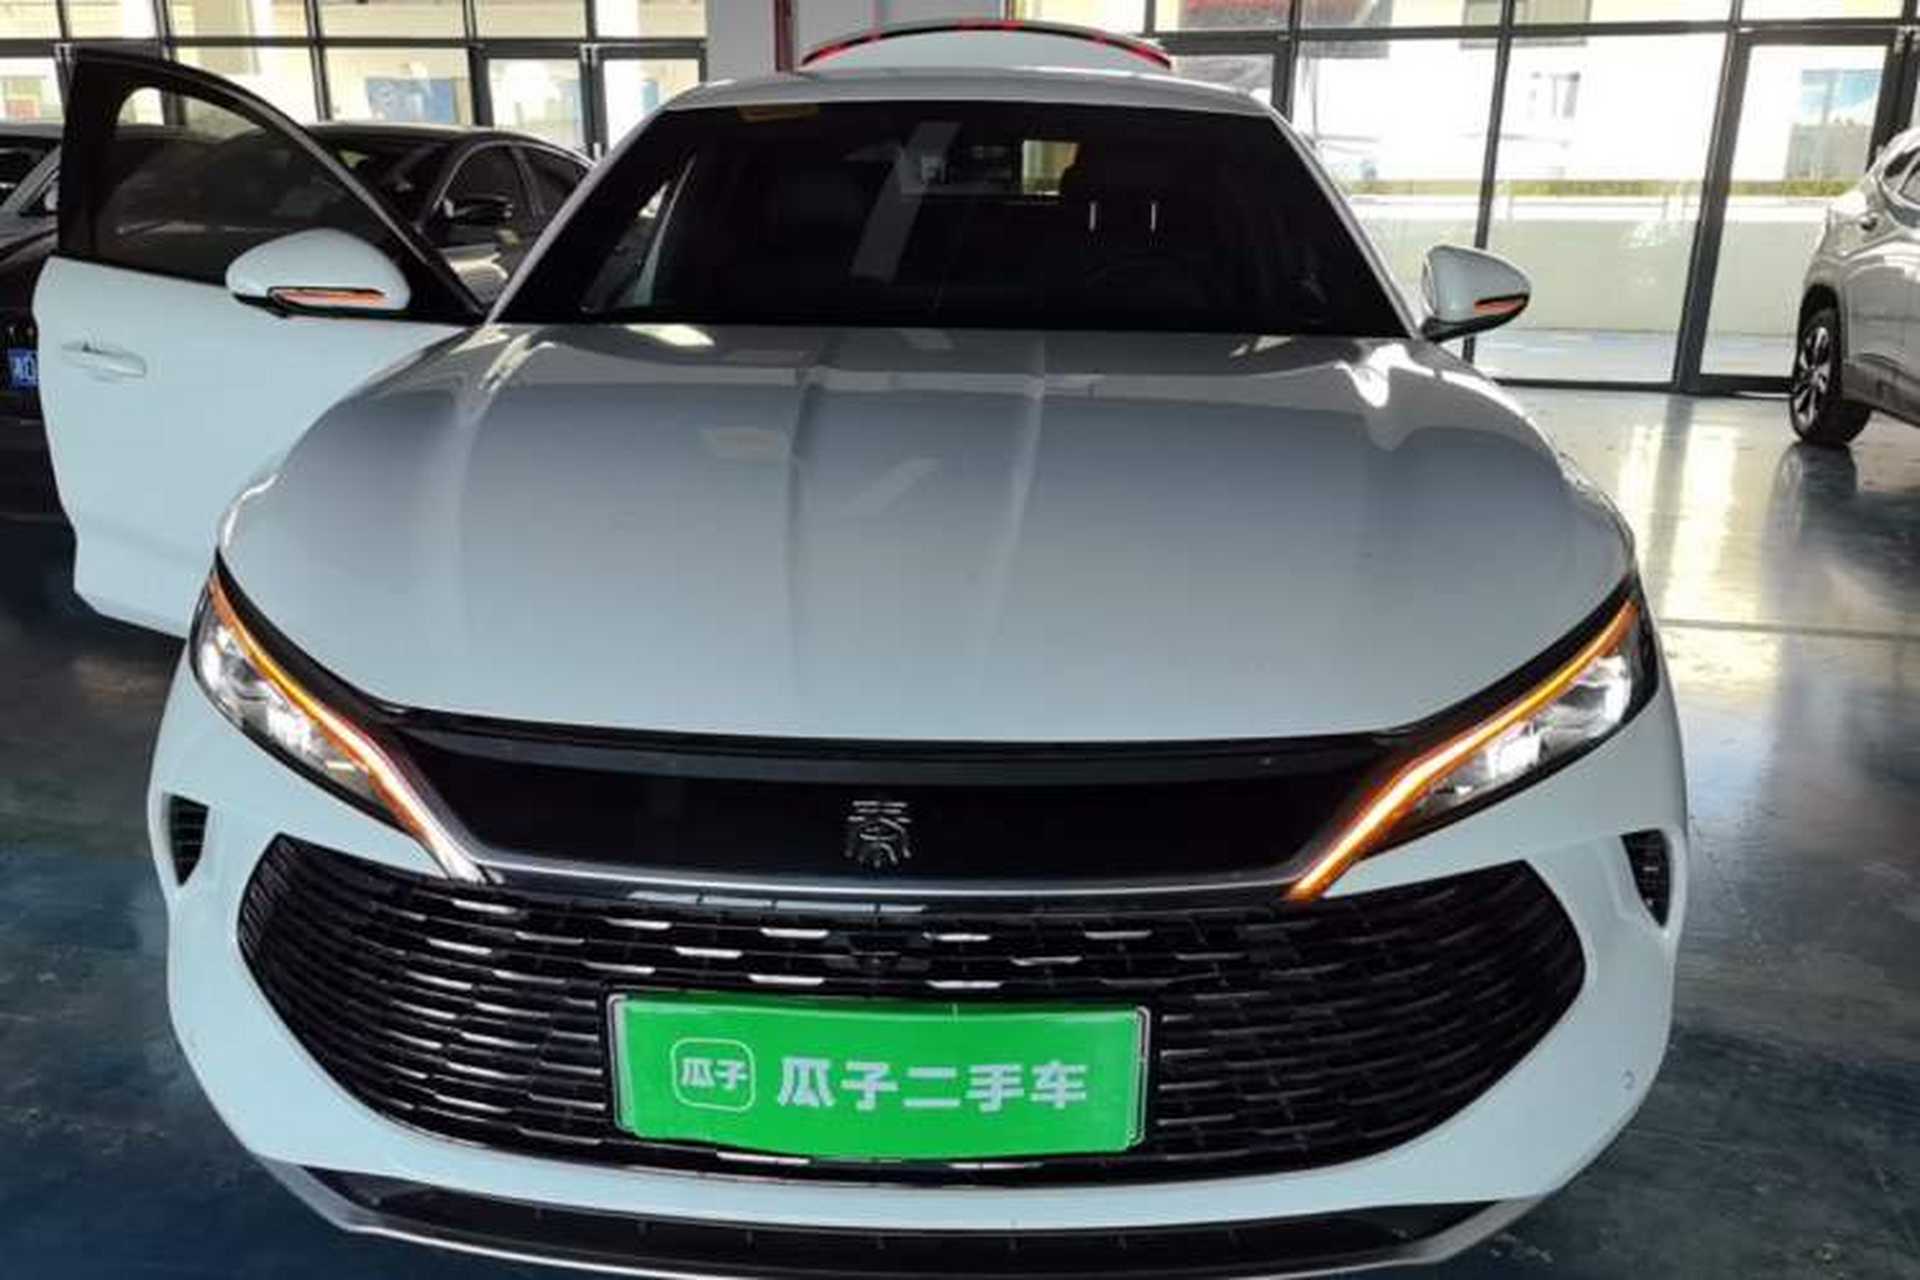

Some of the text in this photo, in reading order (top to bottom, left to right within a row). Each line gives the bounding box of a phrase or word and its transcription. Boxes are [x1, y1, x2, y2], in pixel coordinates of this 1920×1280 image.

[681, 1056, 748, 1091] 瓜子
[776, 1055, 1088, 1111] 瓜子二手车
